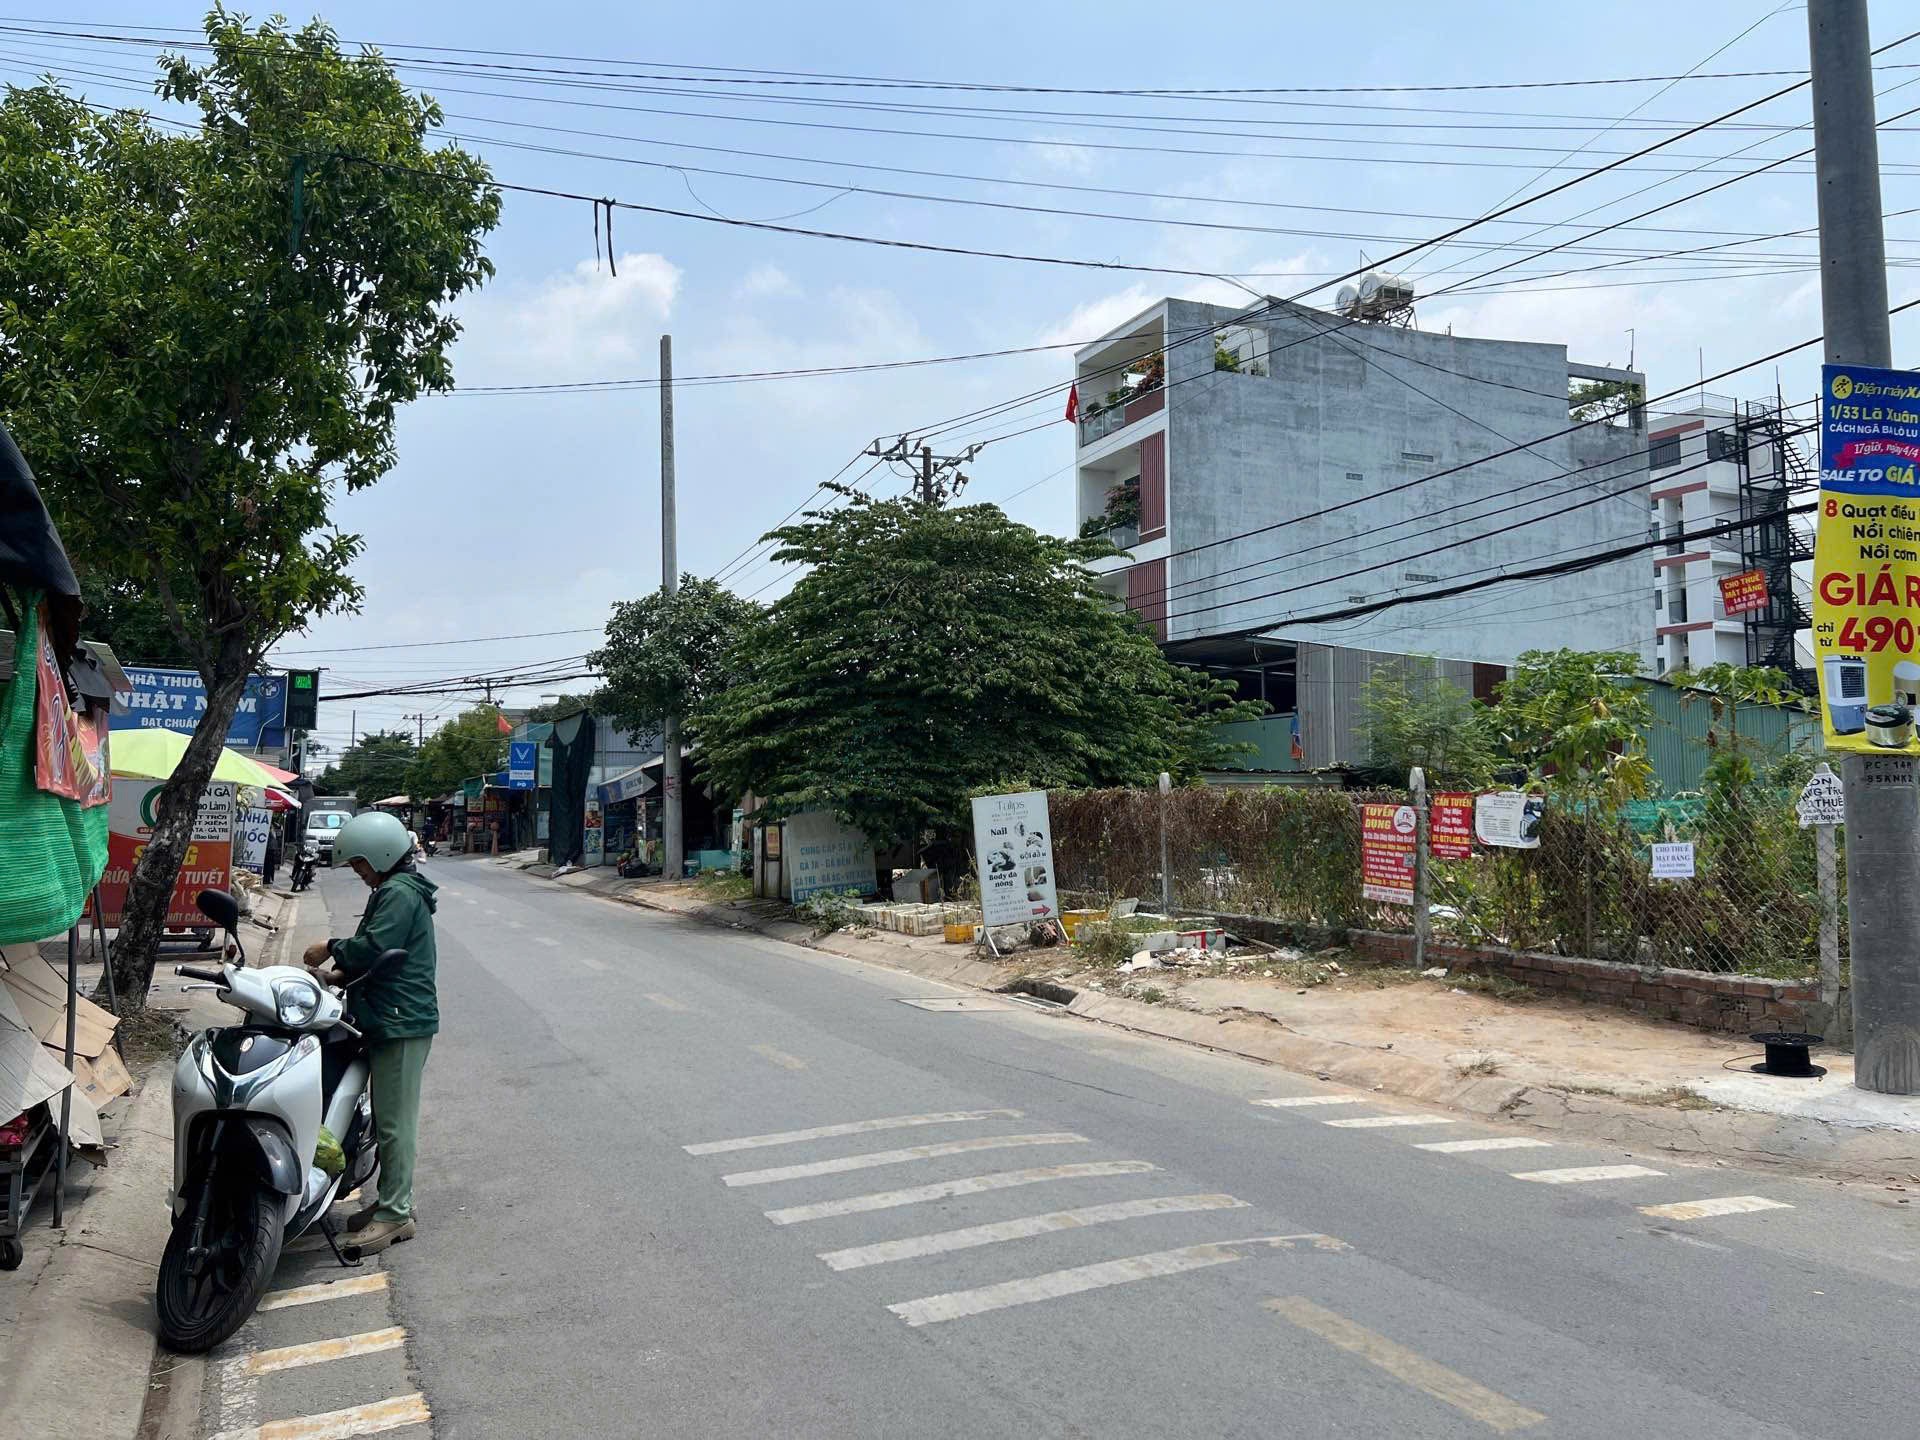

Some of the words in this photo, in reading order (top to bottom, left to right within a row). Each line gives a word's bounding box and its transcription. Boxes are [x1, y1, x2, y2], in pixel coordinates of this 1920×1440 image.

[1830, 403, 1859, 420] 1/33
[1862, 408, 1883, 420] Lã
[1886, 408, 1918, 424] Xuân
[1829, 421, 1856, 433] CÁCH
[1857, 420, 1880, 434] NGÃ
[1882, 425, 1893, 434] BA
[1906, 429, 1918, 437] LU
[1820, 469, 1856, 482] SALE
[1857, 468, 1883, 482] TO
[1885, 463, 1915, 485] GIÁ
[1825, 499, 1838, 518] 8
[1842, 503, 1887, 522] Quạt
[1853, 521, 1883, 539] Nồi
[1860, 543, 1889, 559] Nồi
[1893, 549, 1917, 562] cơm
[1724, 579, 1739, 589] CHO
[1740, 573, 1761, 585] THUÊ
[1819, 563, 1899, 606] GIÁ
[1742, 583, 1762, 595] BẰNG
[1816, 622, 1834, 633] chỉ
[1819, 637, 1833, 647] từ
[163, 673, 207, 688] THUỐ
[114, 690, 187, 713] NHẬT
[194, 695, 257, 713] NM
[141, 717, 162, 728] ĐẠT
[214, 784, 231, 797] GÀ
[1451, 795, 1473, 807] TUYỂN
[1365, 805, 1395, 817] TUYỂN
[990, 826, 1008, 837] Nail
[1365, 818, 1392, 831] DỤNG
[185, 867, 225, 885] TUYẾT
[989, 873, 1007, 882] Body
[995, 880, 1014, 889] nóng
